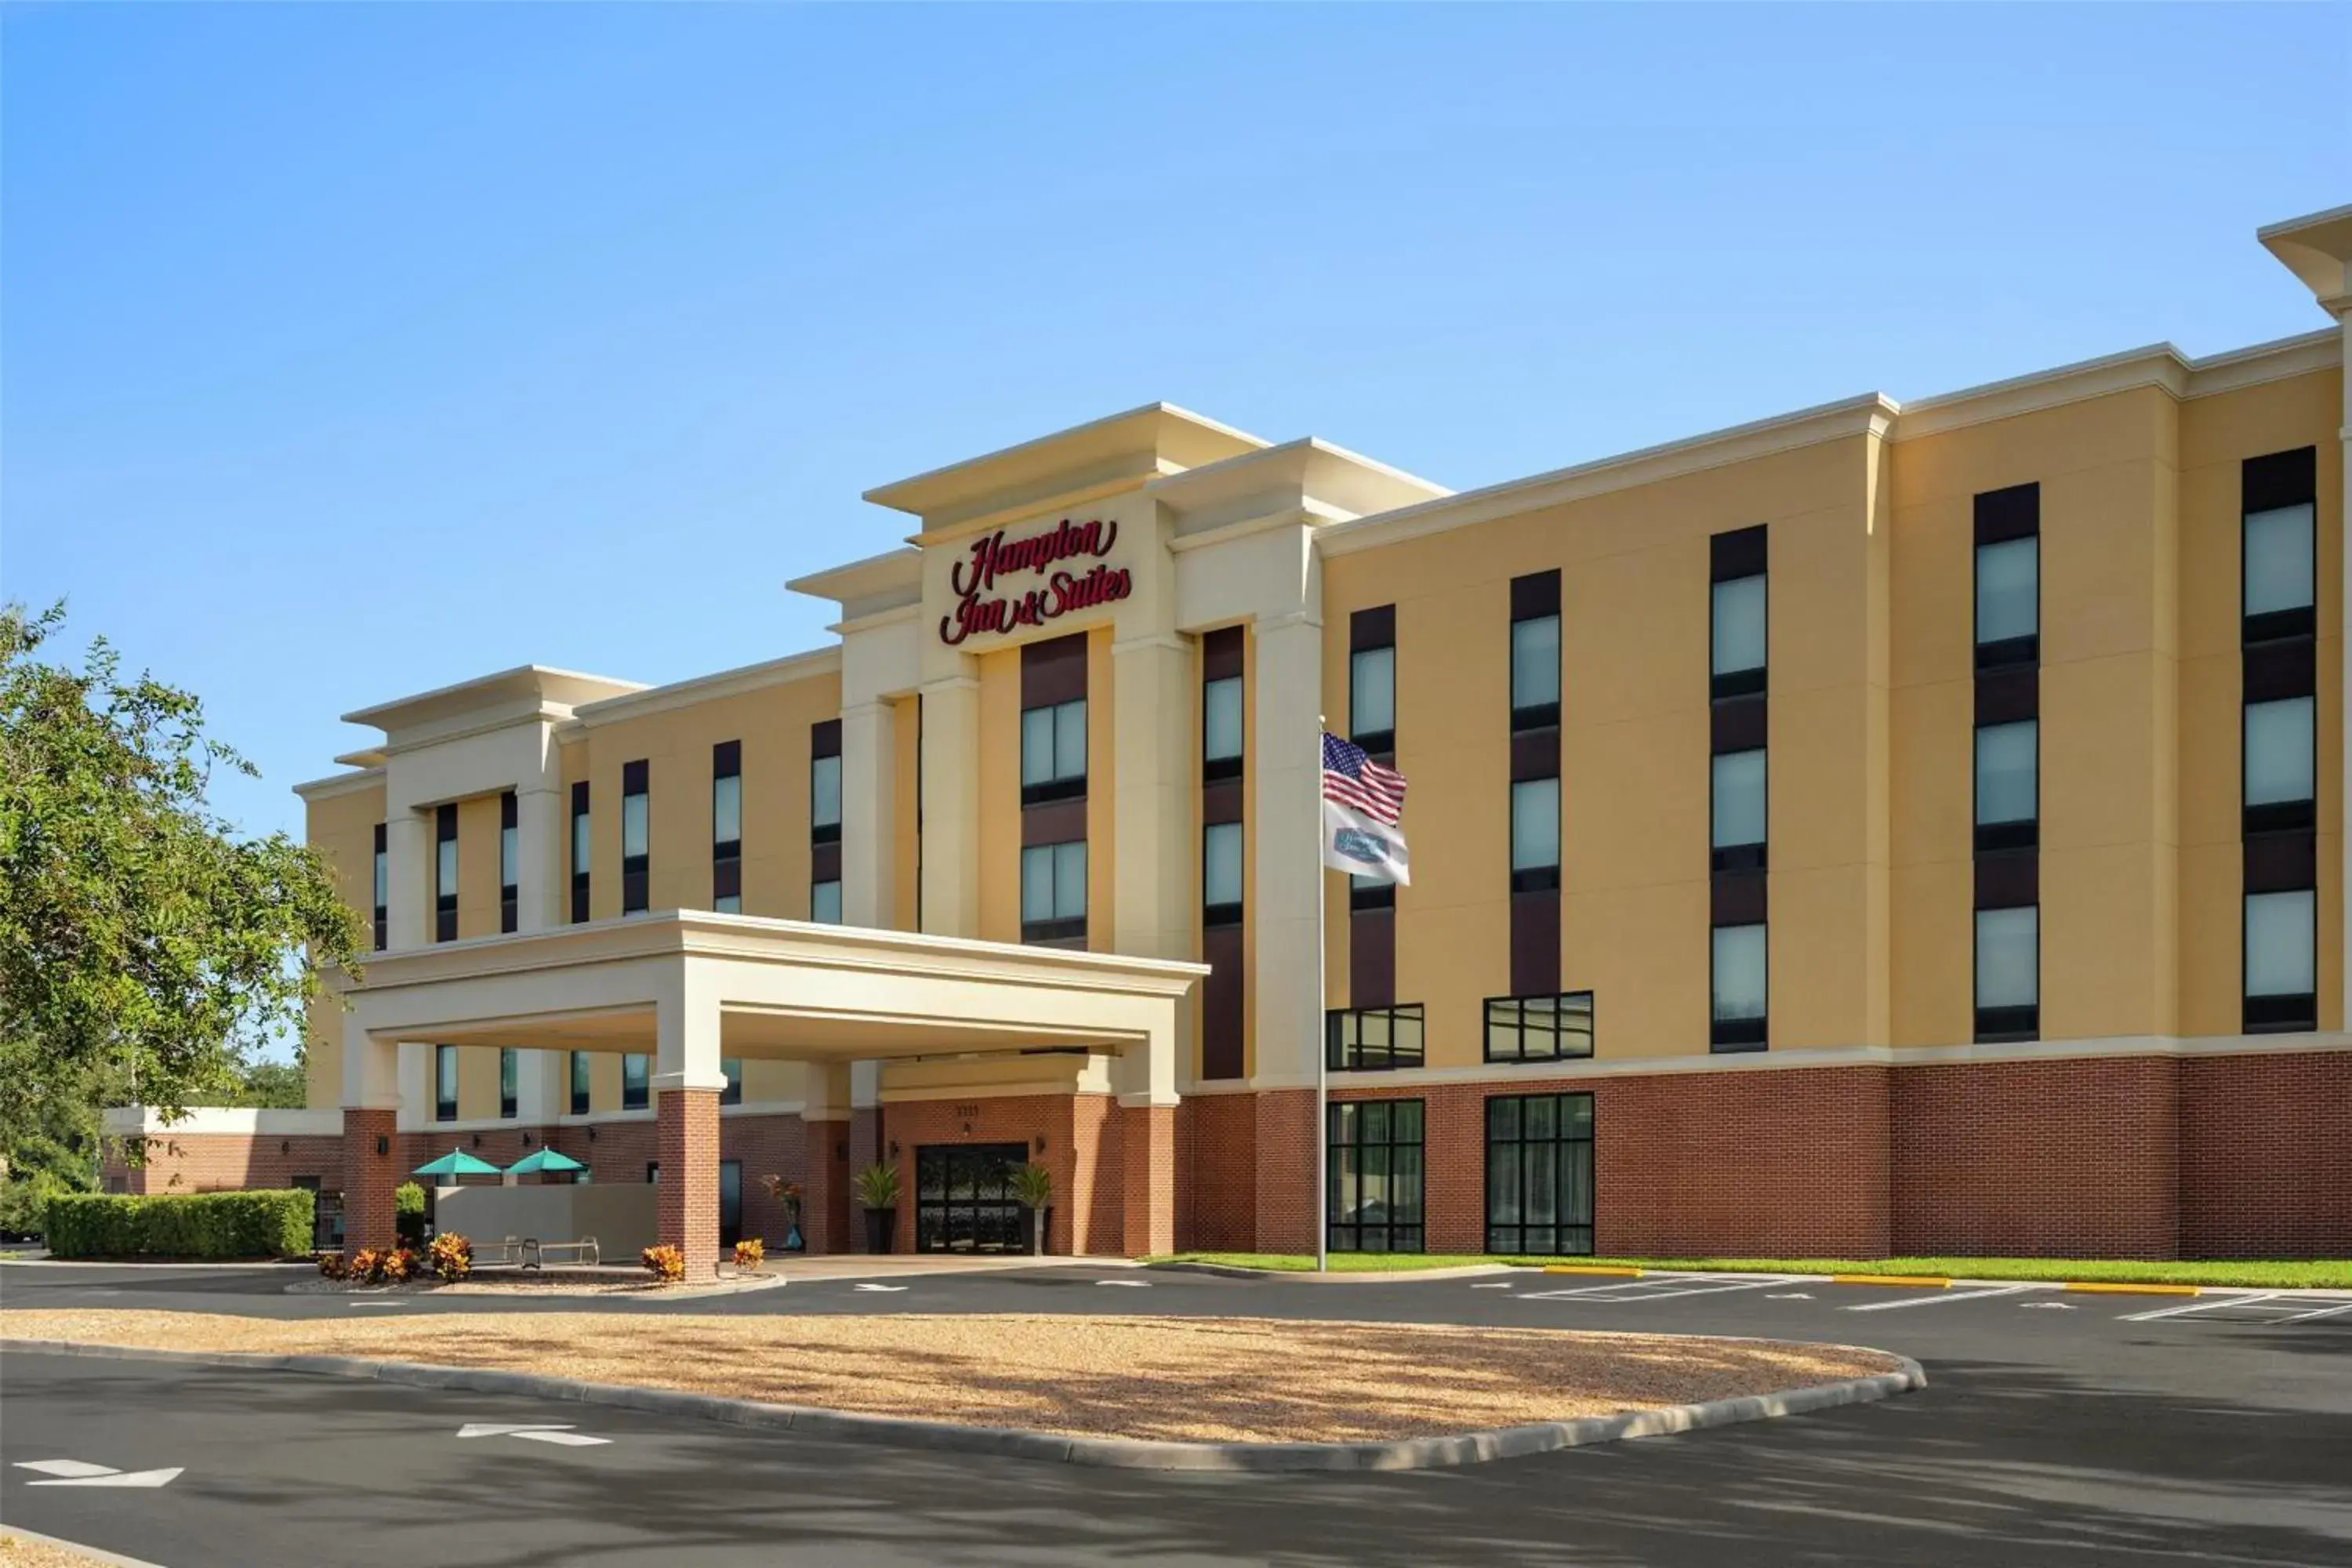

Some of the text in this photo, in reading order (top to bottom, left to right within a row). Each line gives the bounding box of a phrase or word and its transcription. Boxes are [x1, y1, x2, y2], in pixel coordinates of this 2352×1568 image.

[951, 519, 1117, 597] Hampton
[939, 564, 1131, 645] Inn & Suites
